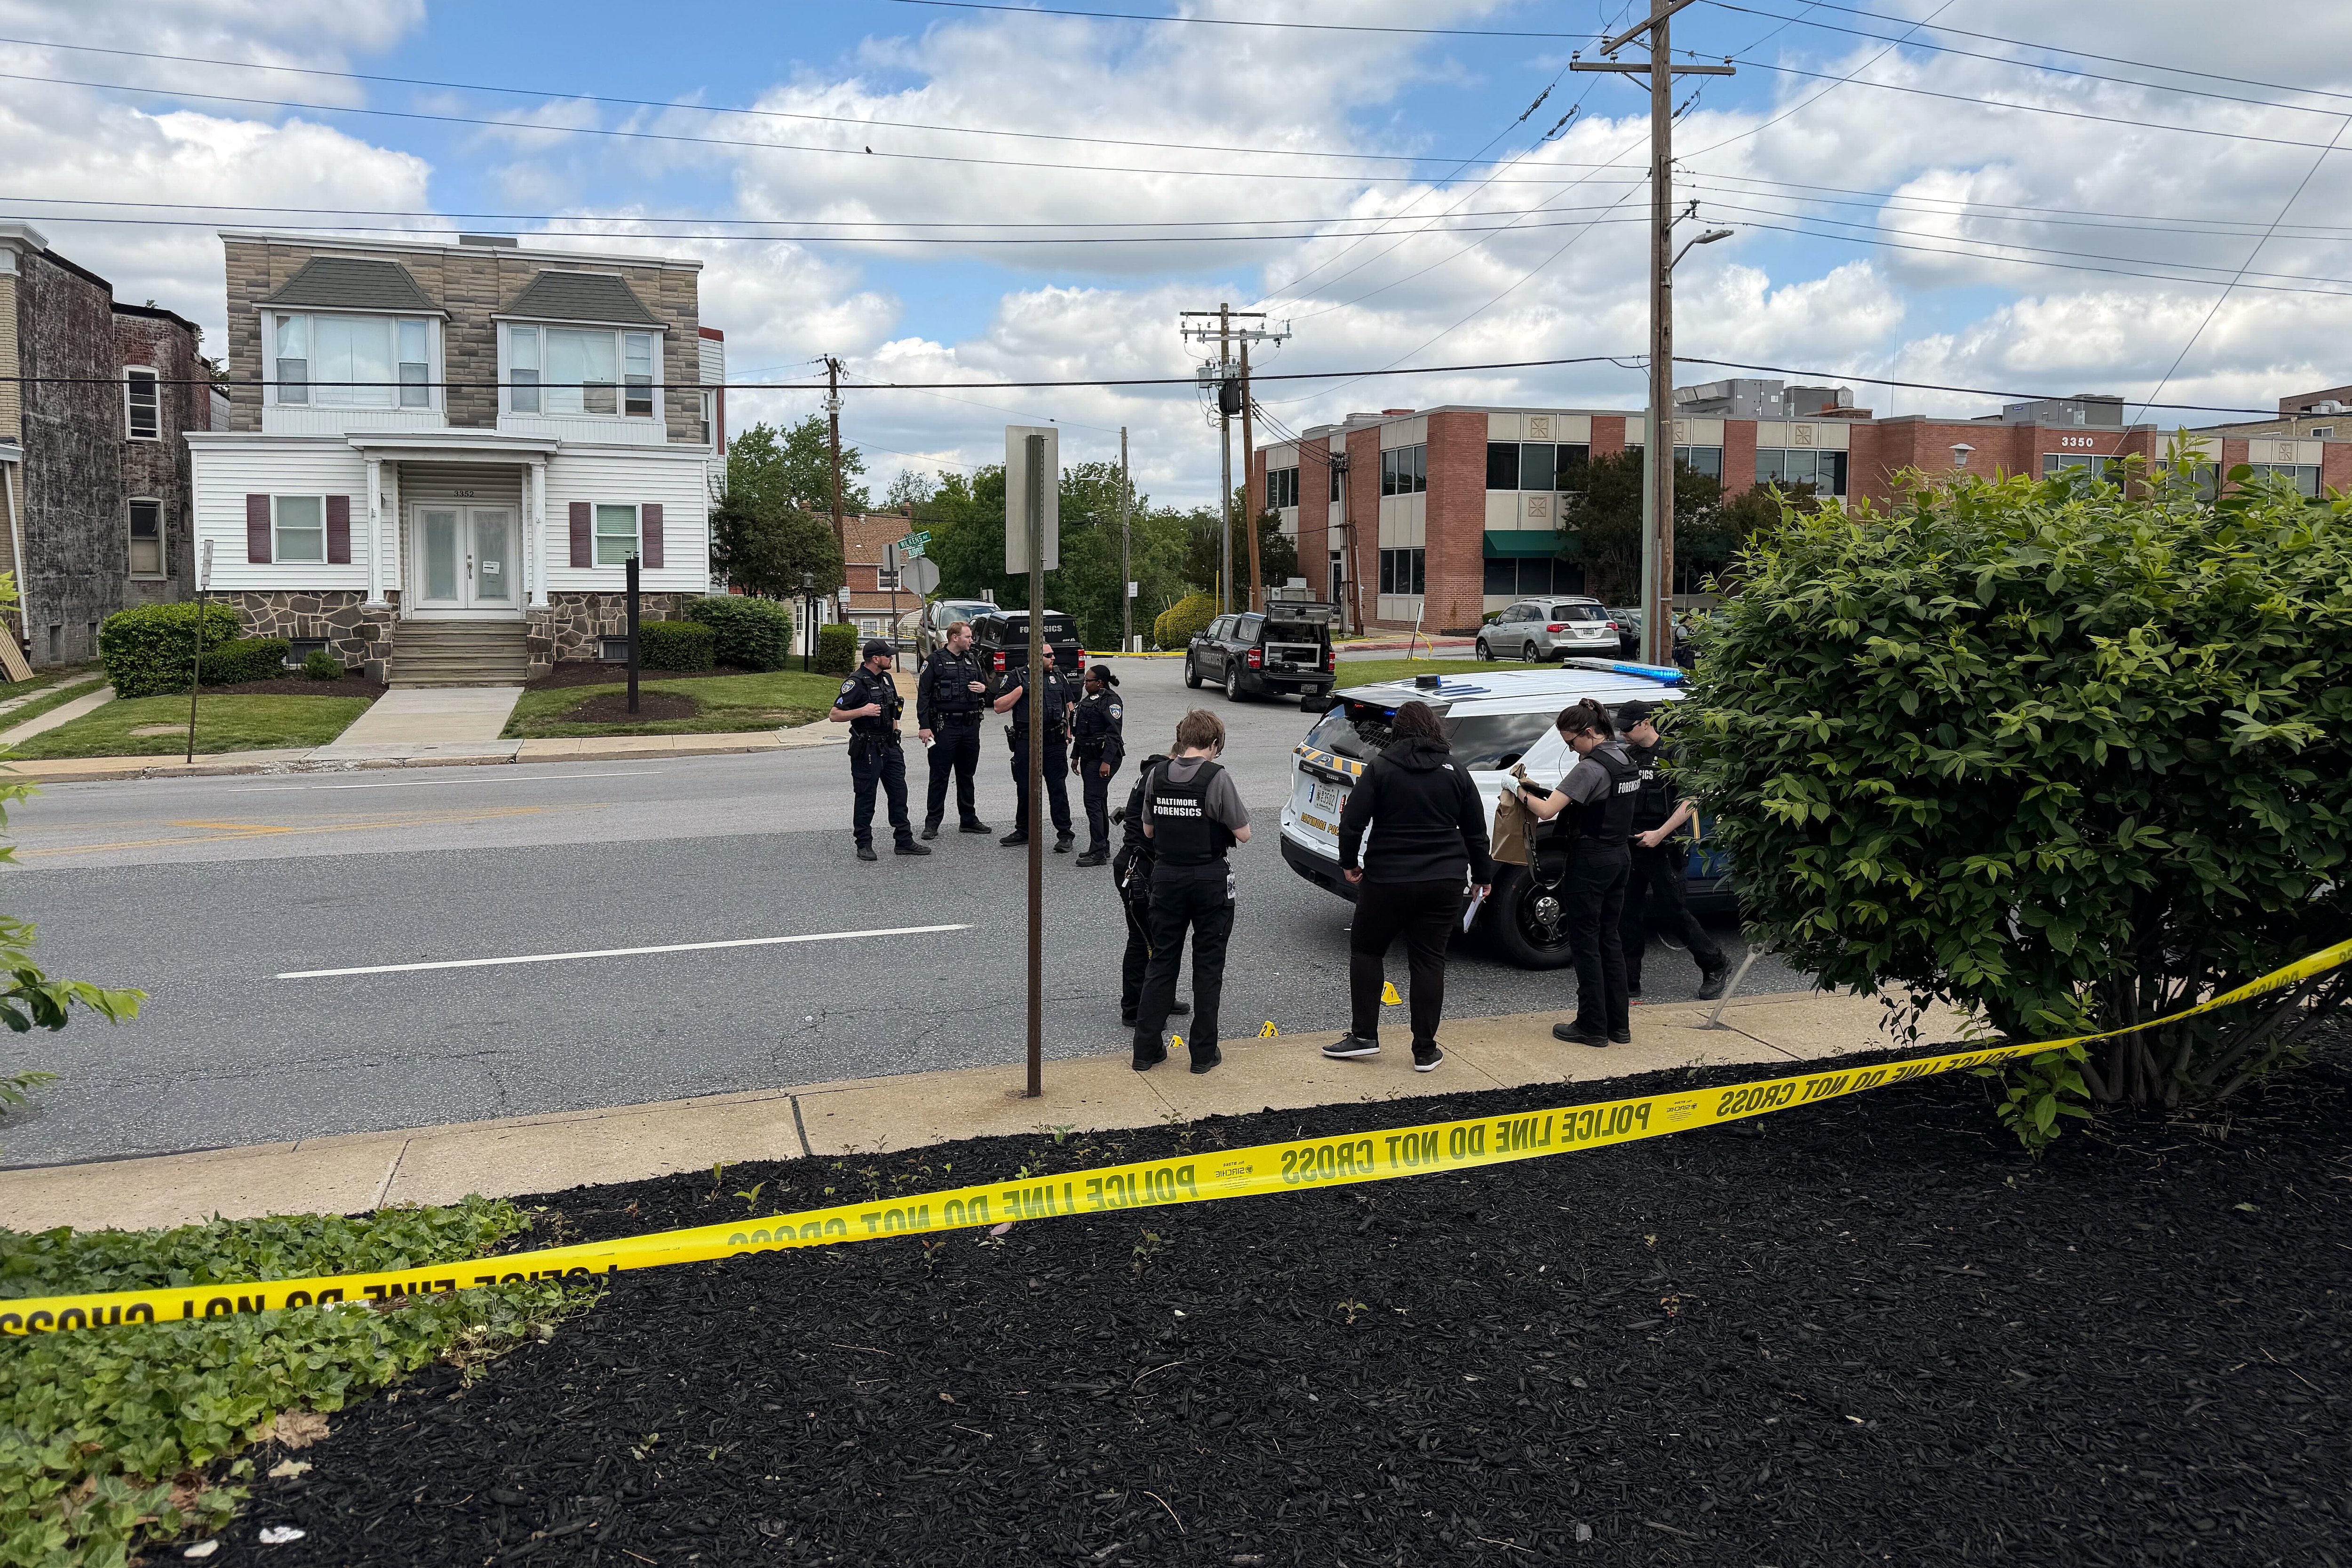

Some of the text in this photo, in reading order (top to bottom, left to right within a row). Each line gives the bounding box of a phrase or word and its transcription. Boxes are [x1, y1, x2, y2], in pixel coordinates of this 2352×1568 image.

[2062, 437, 2093, 447] 3350
[900, 536, 922, 548] WILKENS
[1200, 651, 1222, 666] FORENSICS
[1157, 797, 1197, 806] BALTIMORE
[1153, 805, 1201, 816] FORENSICS
[1261, 1025, 1267, 1036] 2
